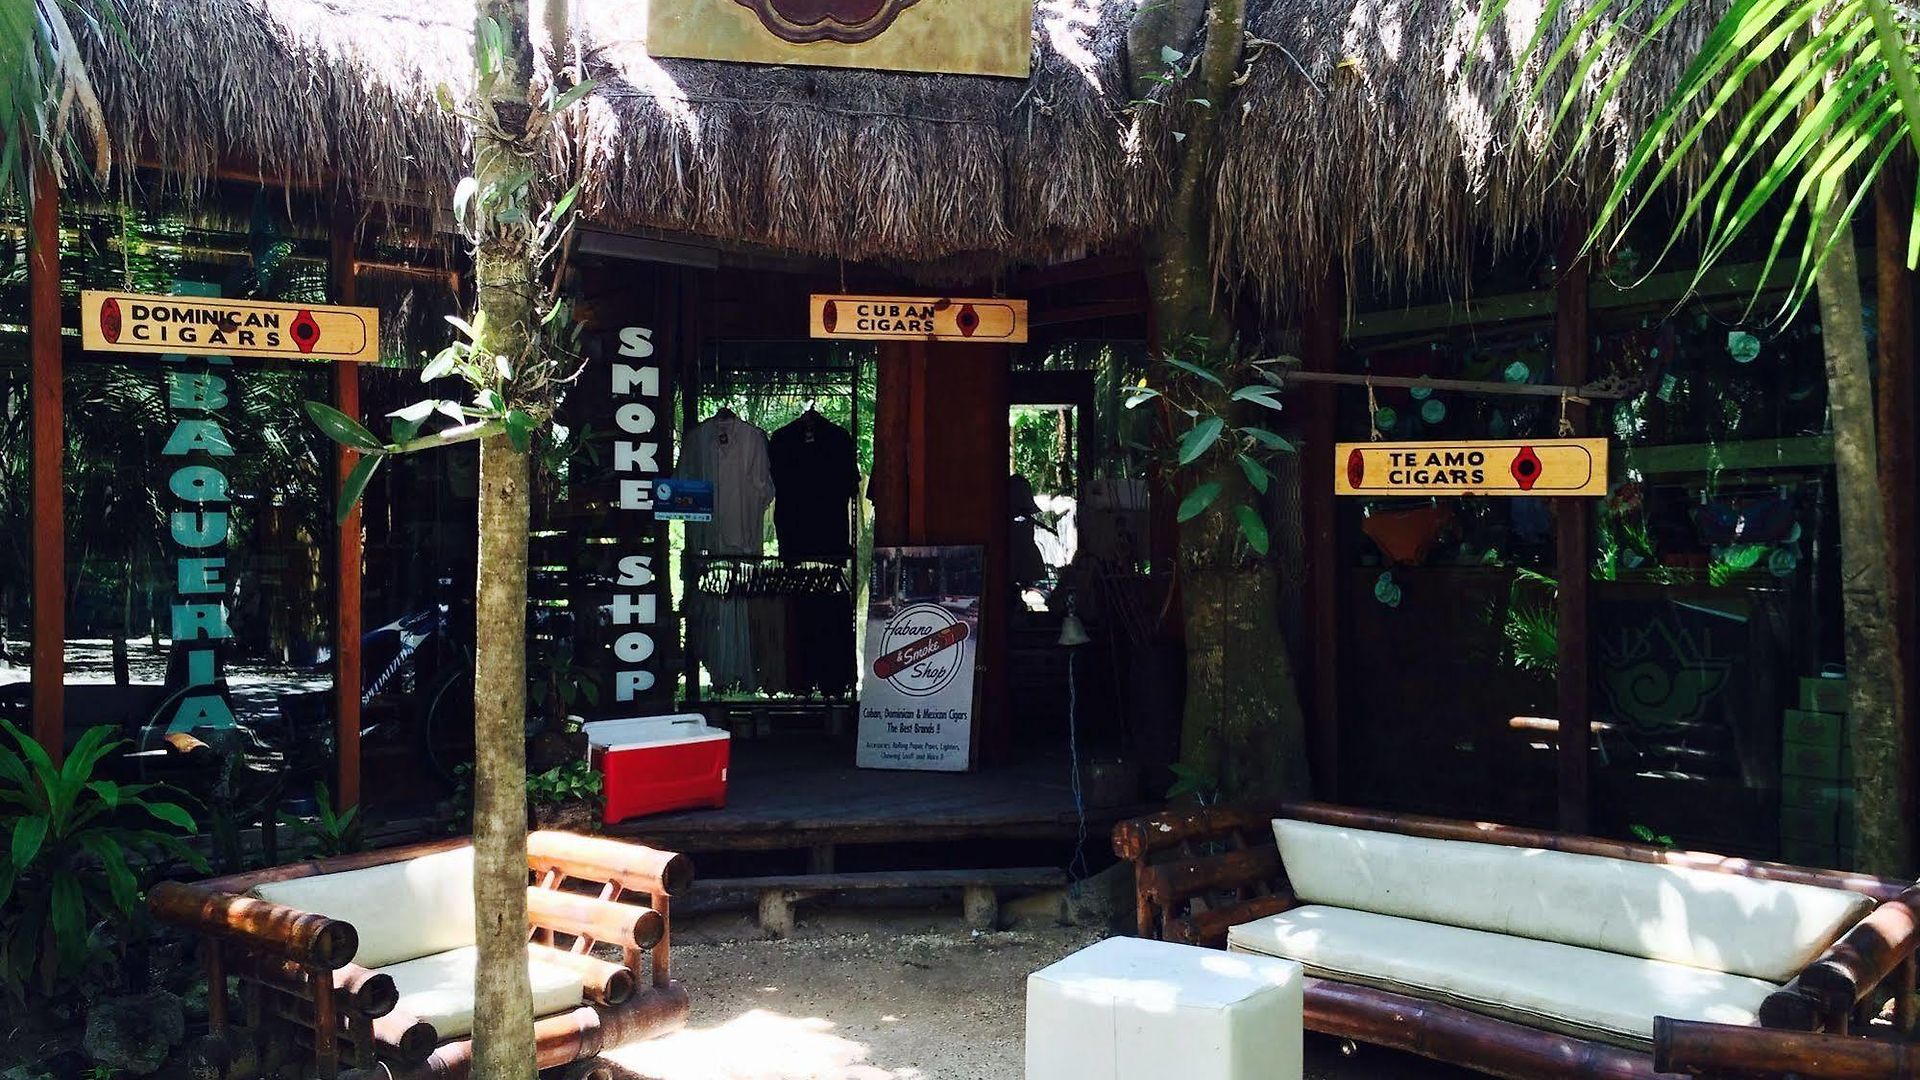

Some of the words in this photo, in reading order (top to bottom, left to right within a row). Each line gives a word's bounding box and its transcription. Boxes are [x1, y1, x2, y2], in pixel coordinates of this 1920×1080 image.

[132, 305, 280, 329] DOMINICAN
[857, 305, 934, 318] CUBAN
[857, 319, 934, 332] CIGARS
[132, 325, 280, 347] CIGARS
[612, 326, 660, 510] SMOKE
[1390, 453, 1417, 467] TE
[1425, 451, 1484, 467] AMO
[1389, 469, 1484, 485] CIGARS
[161, 280, 237, 736] BAQUERIA
[613, 555, 656, 702] SHOP
[884, 620, 932, 636] Habano
[904, 638, 940, 665] Smoke
[911, 661, 947, 684] Shop
[885, 708, 915, 719] Dominican
[916, 709, 921, 719] &
[923, 709, 947, 720] Mexican
[949, 709, 968, 722] Cigars
[887, 722, 898, 734] The
[900, 723, 913, 734] Best
[914, 723, 935, 734] Brands
